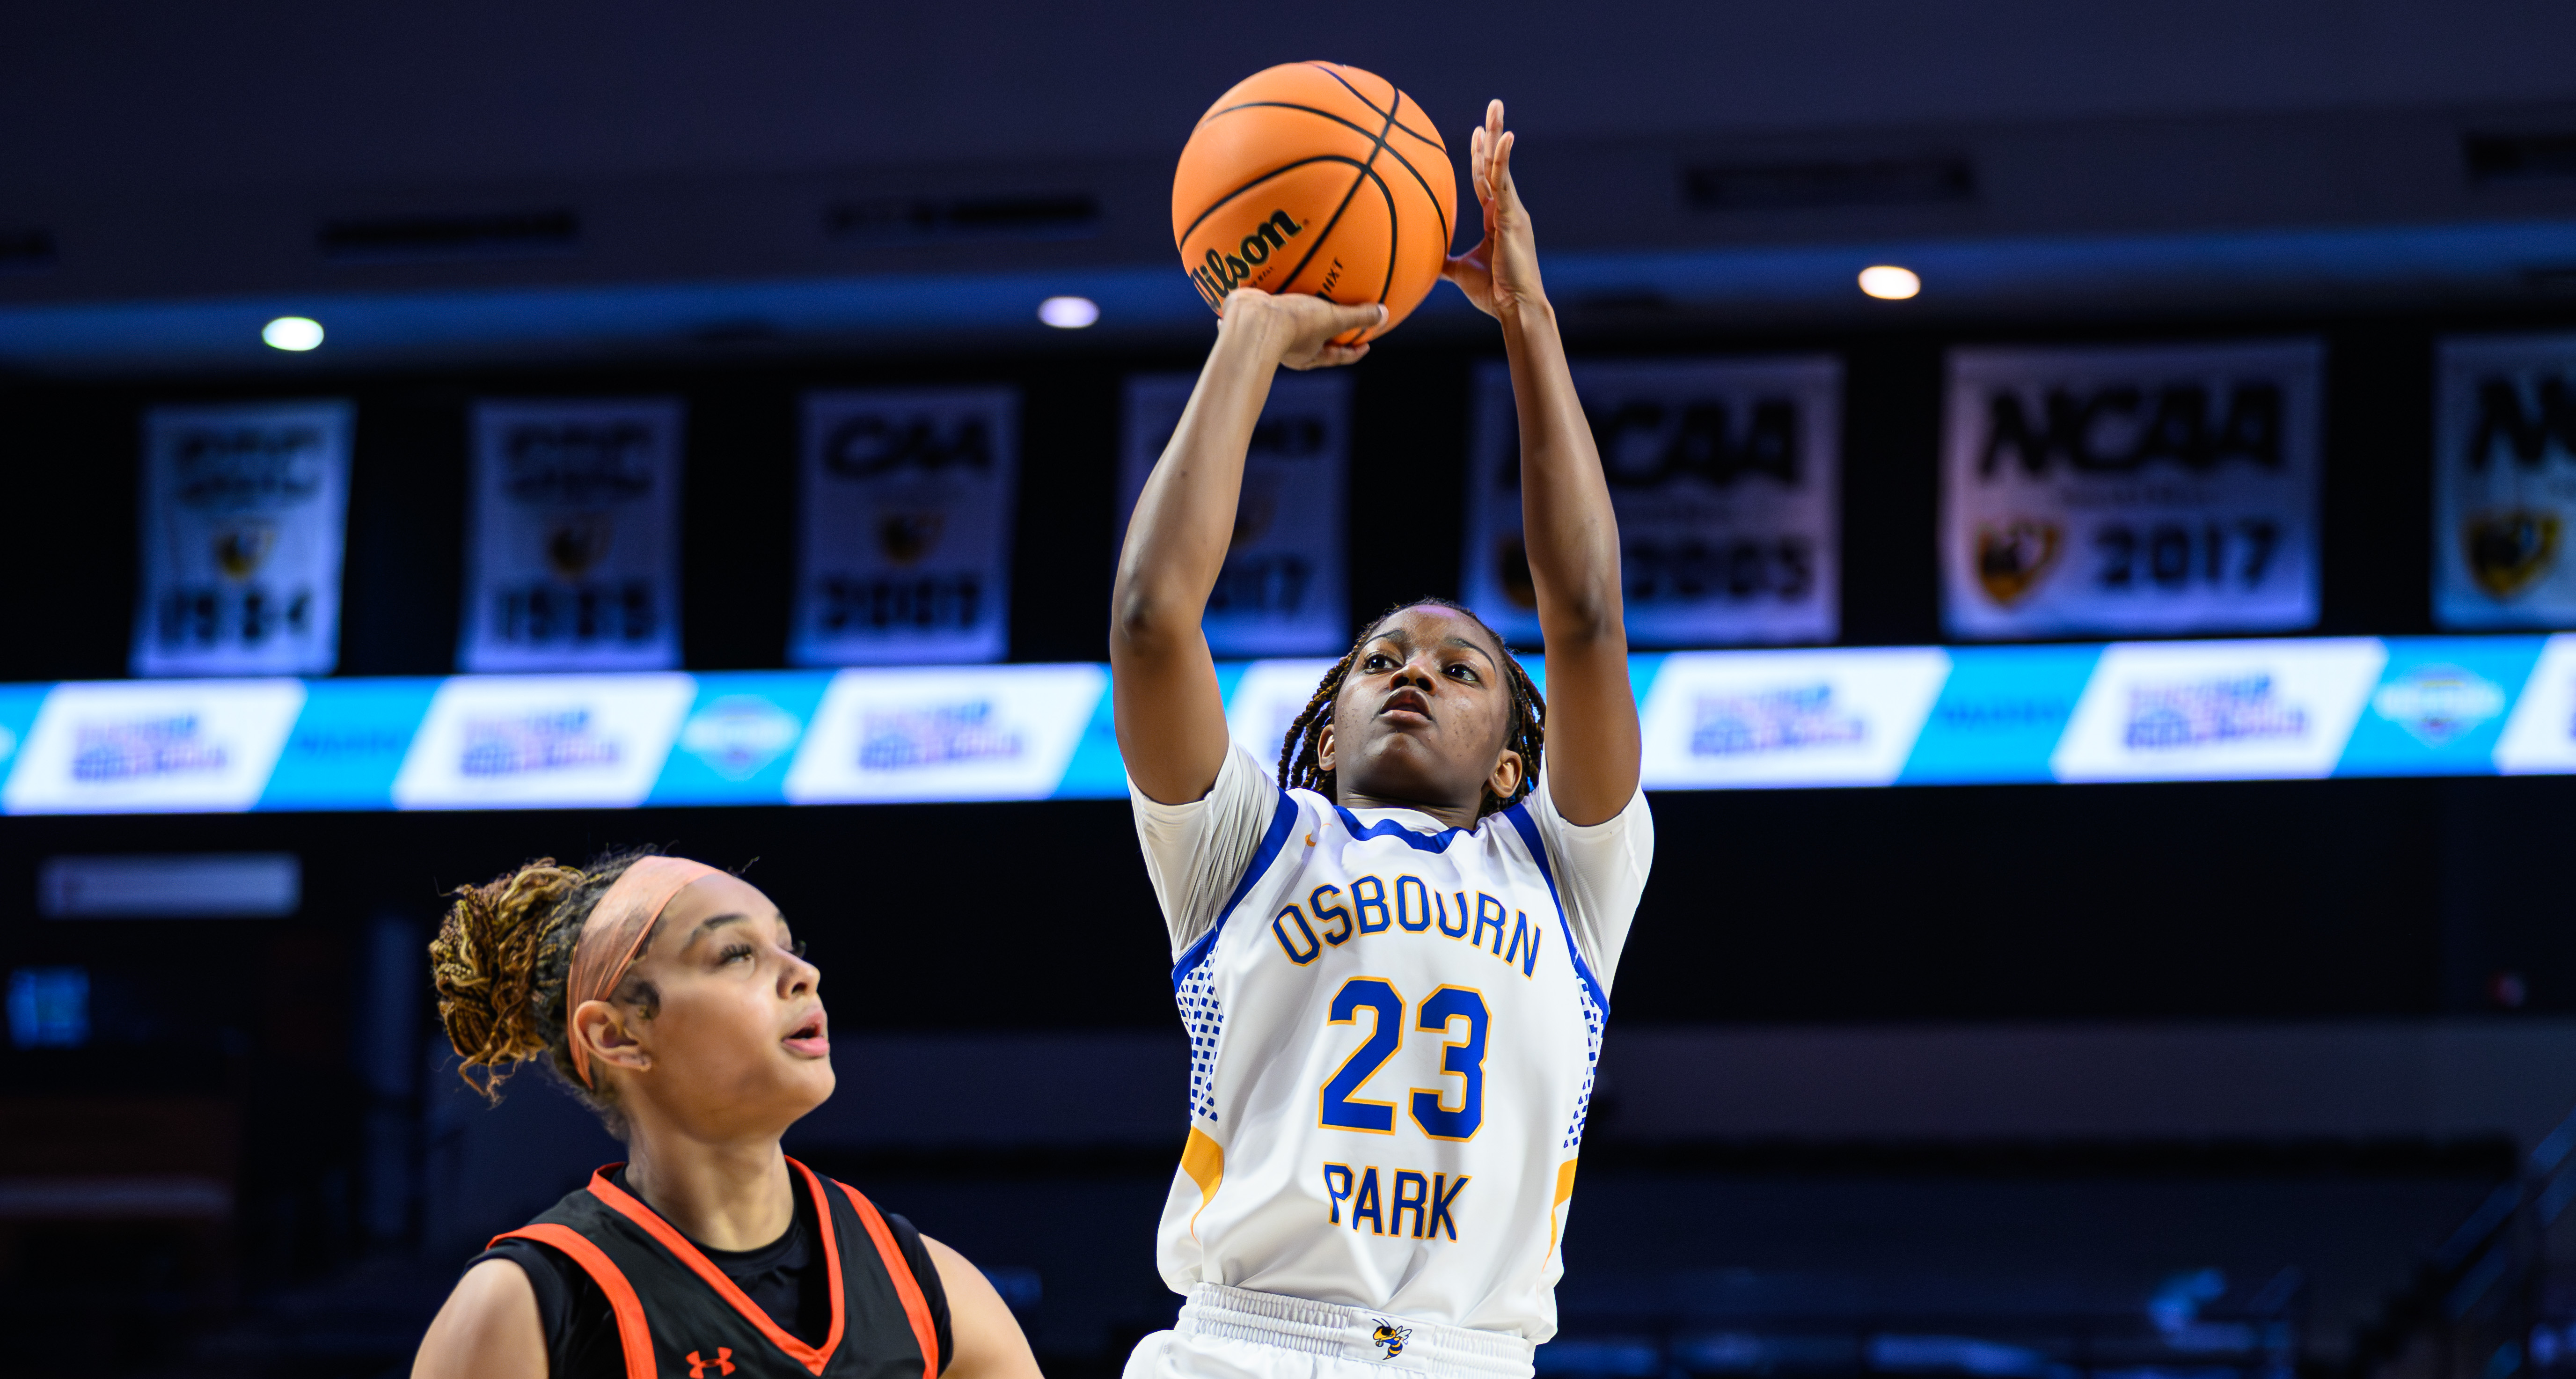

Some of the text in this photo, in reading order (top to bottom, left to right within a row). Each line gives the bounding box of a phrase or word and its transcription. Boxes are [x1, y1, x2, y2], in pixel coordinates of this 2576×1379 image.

[1977, 389, 2285, 483] NCAA
[2093, 519, 2278, 597] 2017
[1271, 873, 1543, 981] OSBOURN
[1318, 976, 1493, 1143] 23
[1323, 1161, 1472, 1243] PARK
